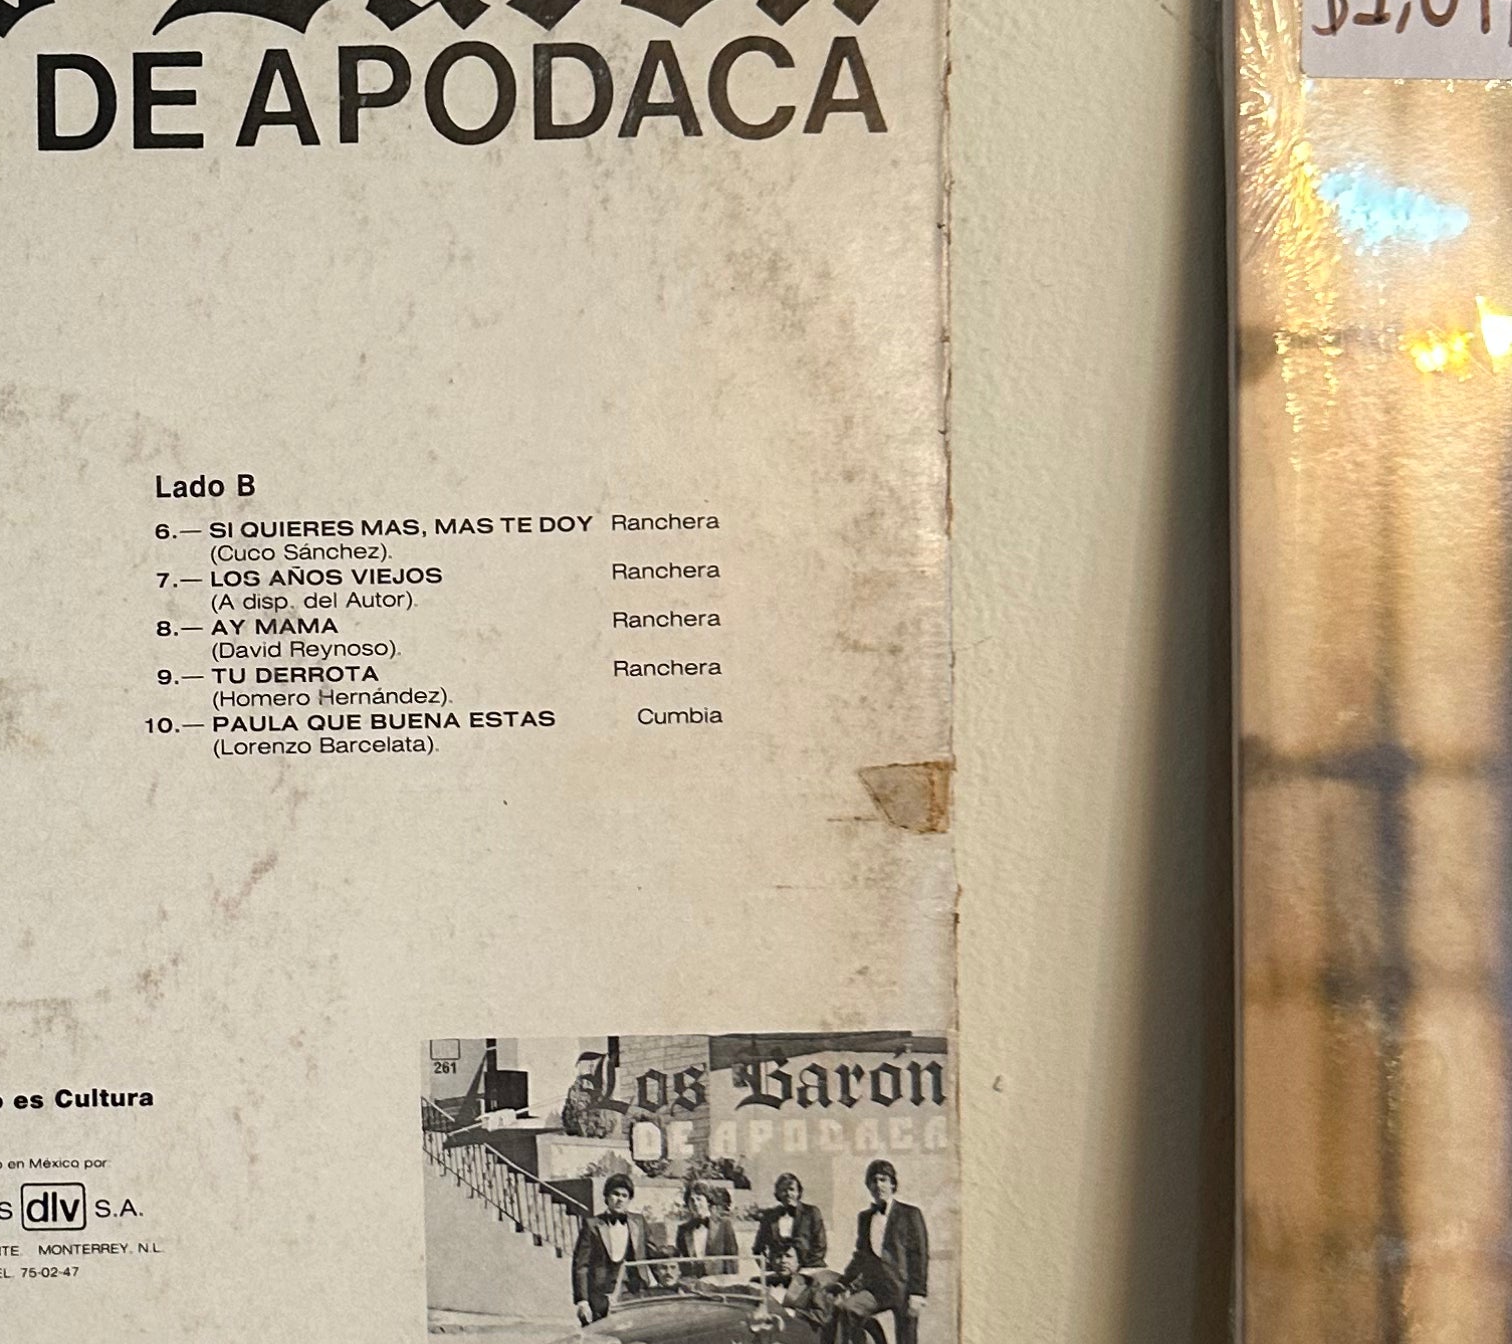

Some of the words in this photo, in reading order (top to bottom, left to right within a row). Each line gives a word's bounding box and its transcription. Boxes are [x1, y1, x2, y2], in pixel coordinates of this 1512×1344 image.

[36, 50, 203, 152] DE
[235, 35, 889, 147] APODACA
[156, 475, 224, 498] Lado
[238, 474, 255, 496] B
[155, 524, 201, 539] 6.—
[210, 521, 233, 539] SI
[241, 520, 354, 538] QUIERES
[362, 519, 426, 537] MAS,
[436, 518, 493, 534] MAS
[500, 517, 532, 533] TE
[540, 516, 592, 532] DOY
[612, 514, 719, 530] Ranchera
[211, 545, 275, 566] (Cuco
[284, 543, 392, 562] Sánchez).
[157, 573, 202, 588] 7.—
[211, 571, 260, 587] LOS
[269, 566, 342, 586] AÑOS
[351, 568, 442, 584] VIEJOS
[613, 563, 720, 580] Ranchera
[212, 594, 234, 614] (A
[243, 593, 294, 613] disp.
[304, 592, 337, 608] del
[346, 591, 418, 610] Autor).
[157, 621, 203, 636] 8.—
[211, 620, 245, 635] AY
[256, 618, 338, 634] MAMA
[613, 611, 721, 628] Ranchera
[212, 641, 281, 662] (David
[291, 640, 401, 660] Reynoso).
[158, 670, 204, 685] 9.—
[211, 668, 245, 684] TU
[256, 666, 378, 683] DERROTA
[614, 660, 722, 676] Ranchera
[213, 691, 310, 711] (Homero
[319, 687, 453, 707] Hernández).
[145, 718, 204, 733] 10.—
[213, 716, 298, 732] PAULA
[308, 715, 361, 730] QUE
[371, 713, 460, 729] BUENA
[470, 711, 555, 727] ESTAS
[638, 707, 723, 724] Cumbia
[214, 739, 311, 758] (Lorenzo
[320, 736, 438, 755] Barcelata).
[434, 1061, 456, 1074] 261
[735, 1056, 947, 1110] Baron
[14, 1095, 43, 1109] es
[55, 1088, 153, 1108] Cultura
[8, 1161, 24, 1169] en
[30, 1159, 79, 1168] México
[27, 1192, 80, 1222] dlv
[95, 1199, 143, 1218] S.A.
[21, 1267, 79, 1278] 75-02-47
